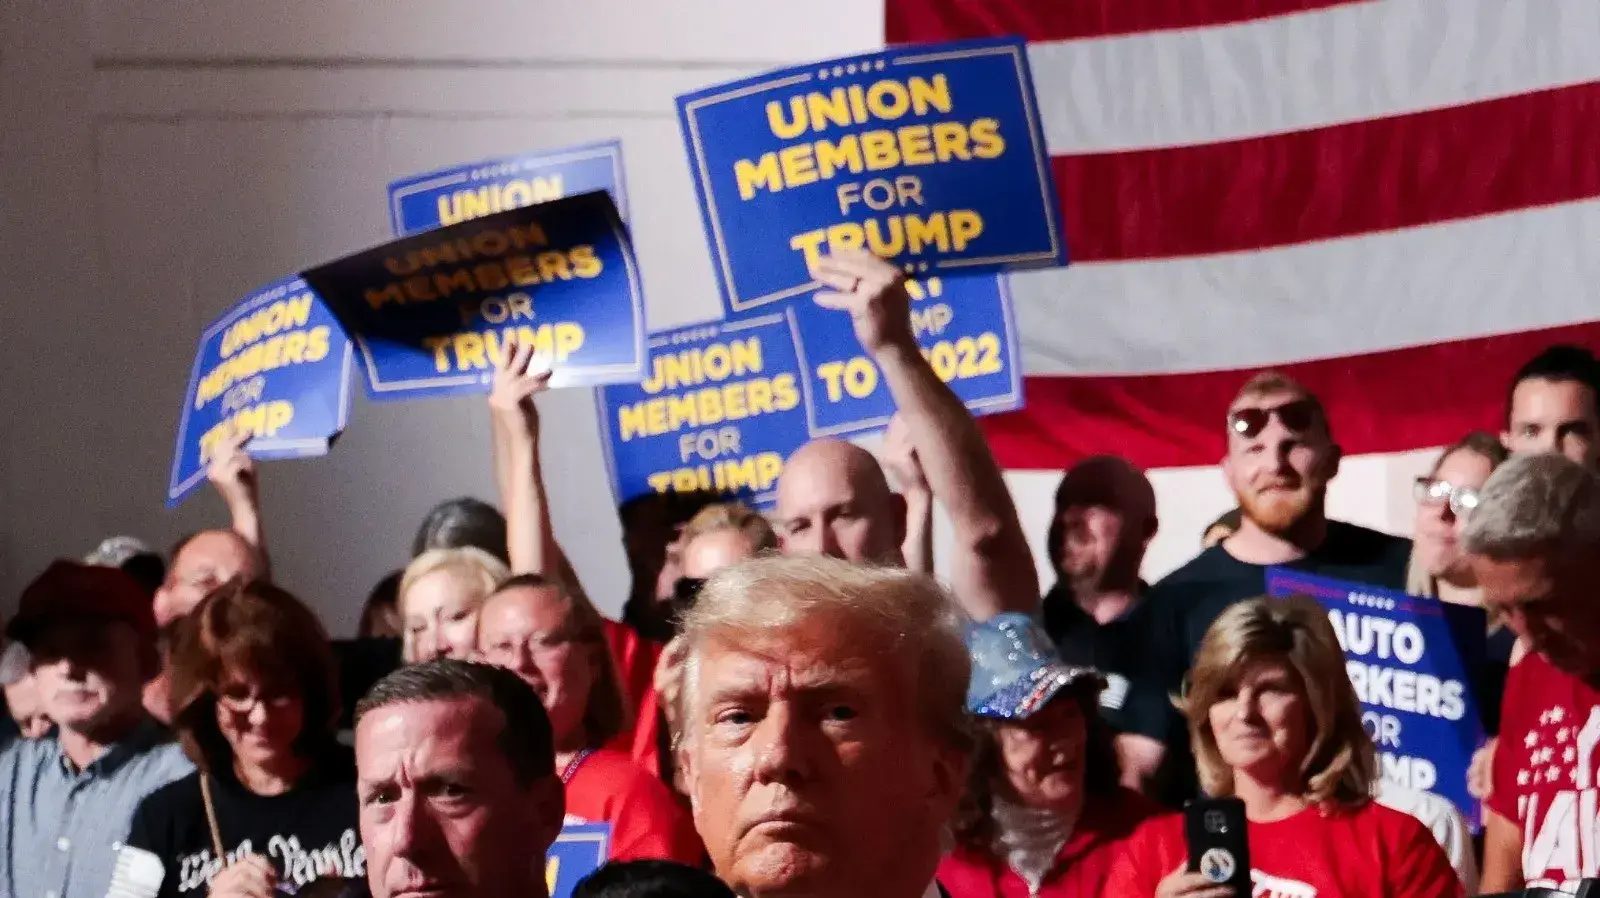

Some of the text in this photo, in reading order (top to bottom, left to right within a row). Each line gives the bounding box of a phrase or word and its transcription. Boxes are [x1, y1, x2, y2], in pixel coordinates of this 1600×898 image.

[766, 72, 953, 140] UNION
[733, 117, 1006, 200] MEMBERS
[436, 173, 564, 227] UNION
[836, 175, 924, 216] FOR
[363, 244, 604, 311] MEMBERS
[384, 221, 548, 276] UNION
[220, 291, 315, 359] UNION
[421, 321, 585, 373] TRUMP
[195, 325, 331, 411] MEMBERS
[221, 375, 266, 417] FOR
[817, 331, 1004, 402] TO 022
[619, 373, 799, 442] MEMBERS
[678, 425, 742, 464] FOR
[1345, 659, 1466, 721] RKERS
[1361, 711, 1402, 748] OR
